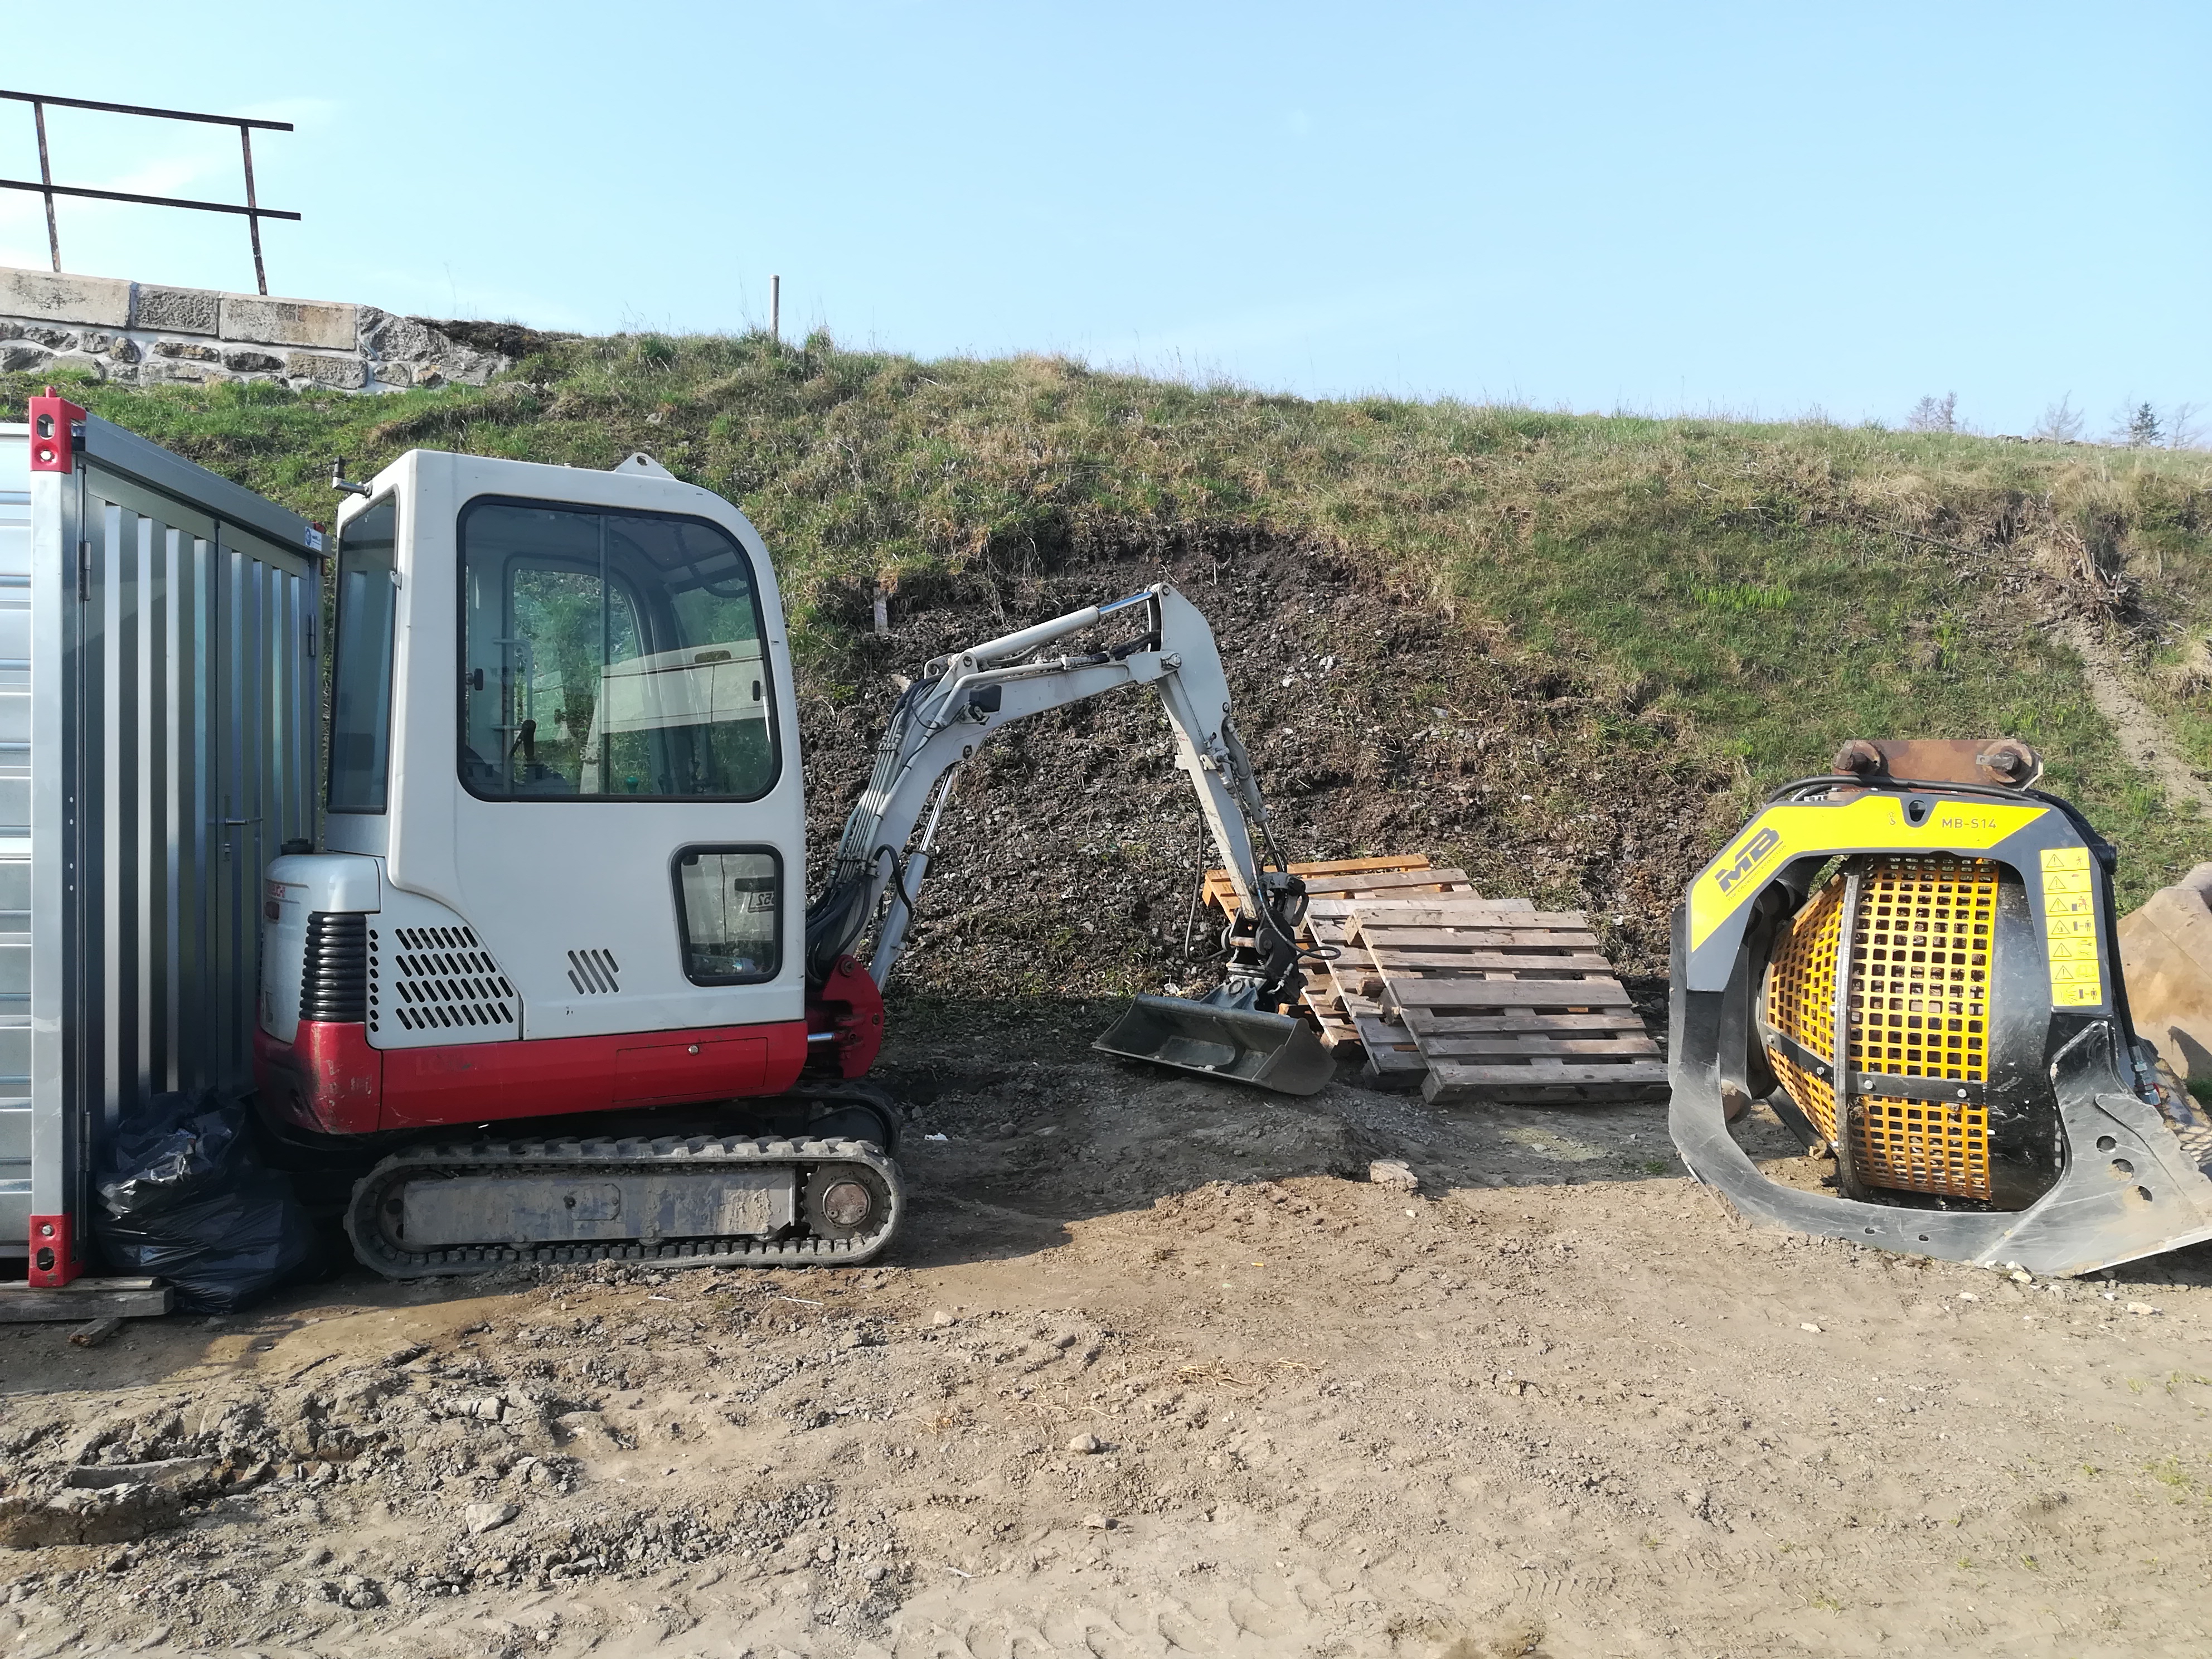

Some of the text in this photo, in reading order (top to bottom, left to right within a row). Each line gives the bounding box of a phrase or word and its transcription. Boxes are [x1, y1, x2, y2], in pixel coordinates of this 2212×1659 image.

[1942, 818, 1997, 829] MB-S14
[1714, 827, 1780, 893] MB
[1728, 892, 1736, 901] THE
[1760, 844, 1787, 870] EVOLUTION
